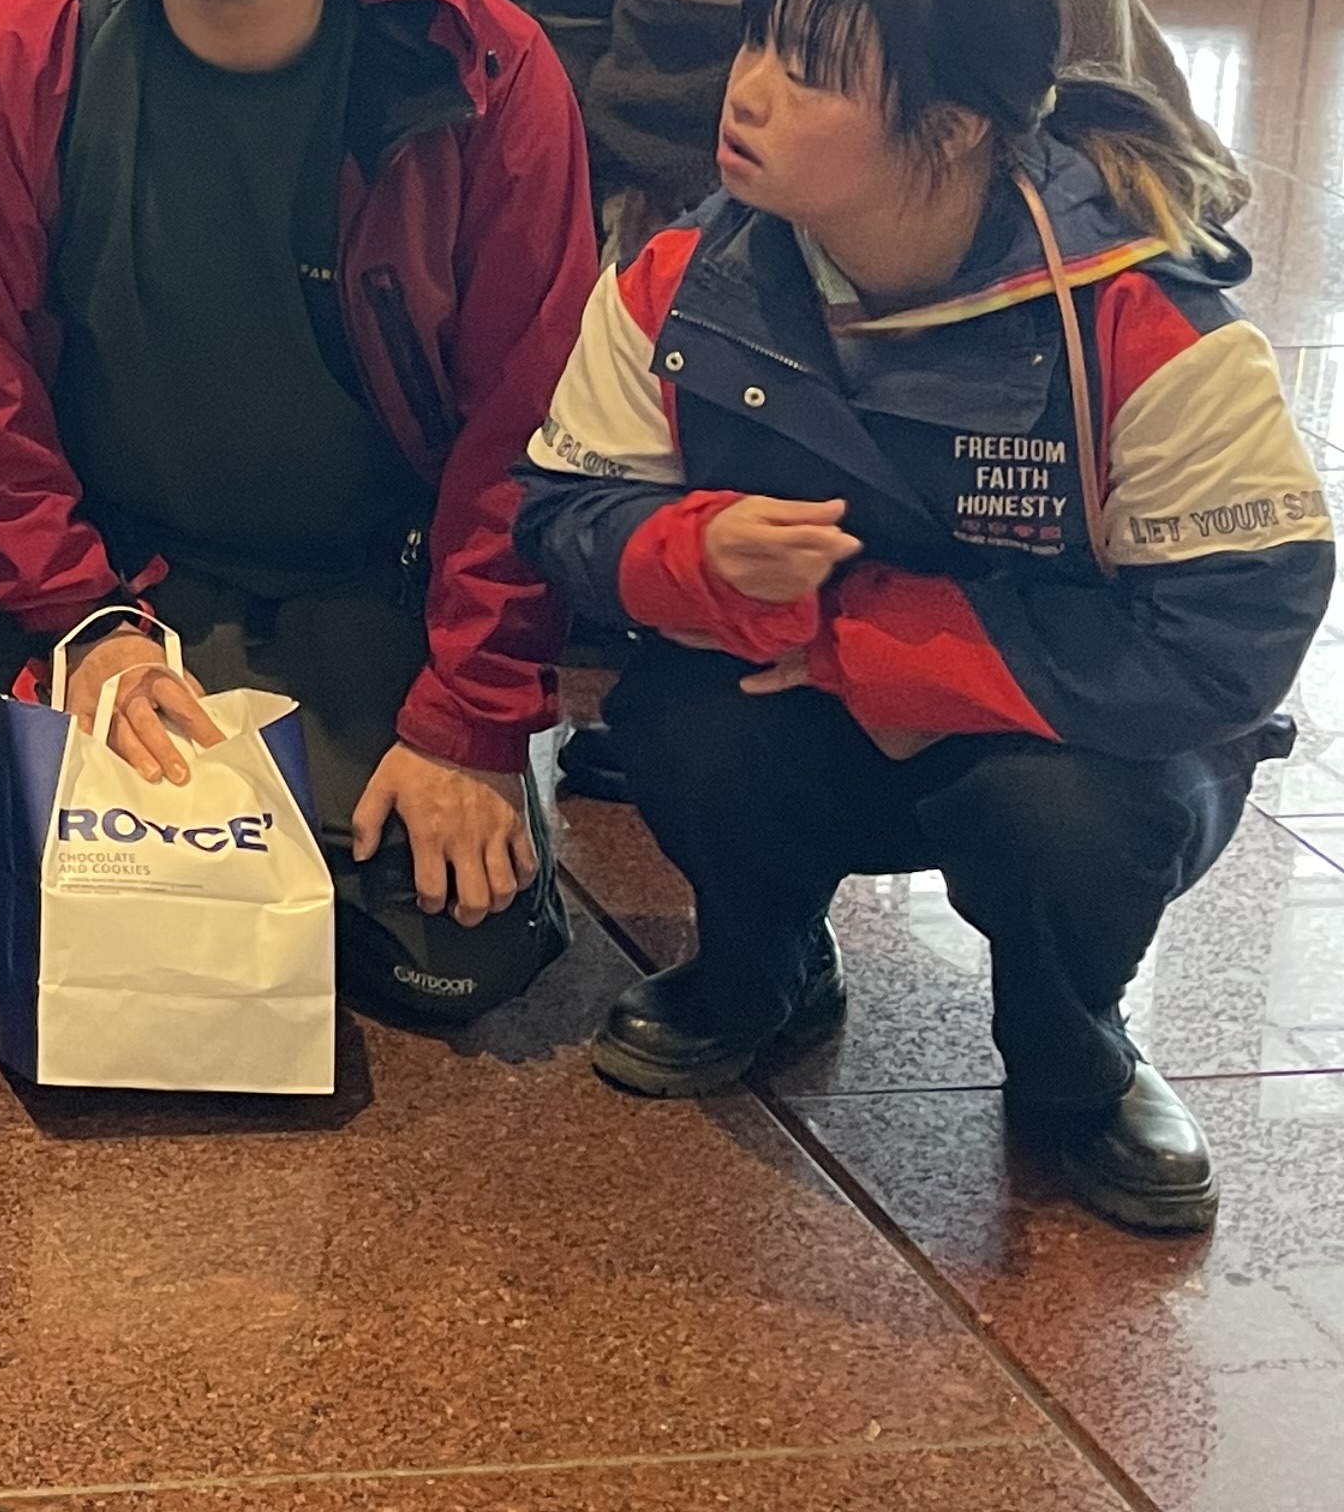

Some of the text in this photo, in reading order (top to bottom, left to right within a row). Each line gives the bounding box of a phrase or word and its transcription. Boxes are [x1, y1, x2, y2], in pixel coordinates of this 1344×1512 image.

[954, 435, 1066, 464] FREEDOM
[976, 466, 1049, 490] FAITH
[957, 495, 1067, 518] HONESTY
[1129, 516, 1180, 544] LET
[1190, 498, 1279, 537] YOUR
[58, 852, 136, 864] CHOCOLATE
[58, 863, 151, 876] AND COOKIES
[393, 965, 474, 995] OUTDOOR
